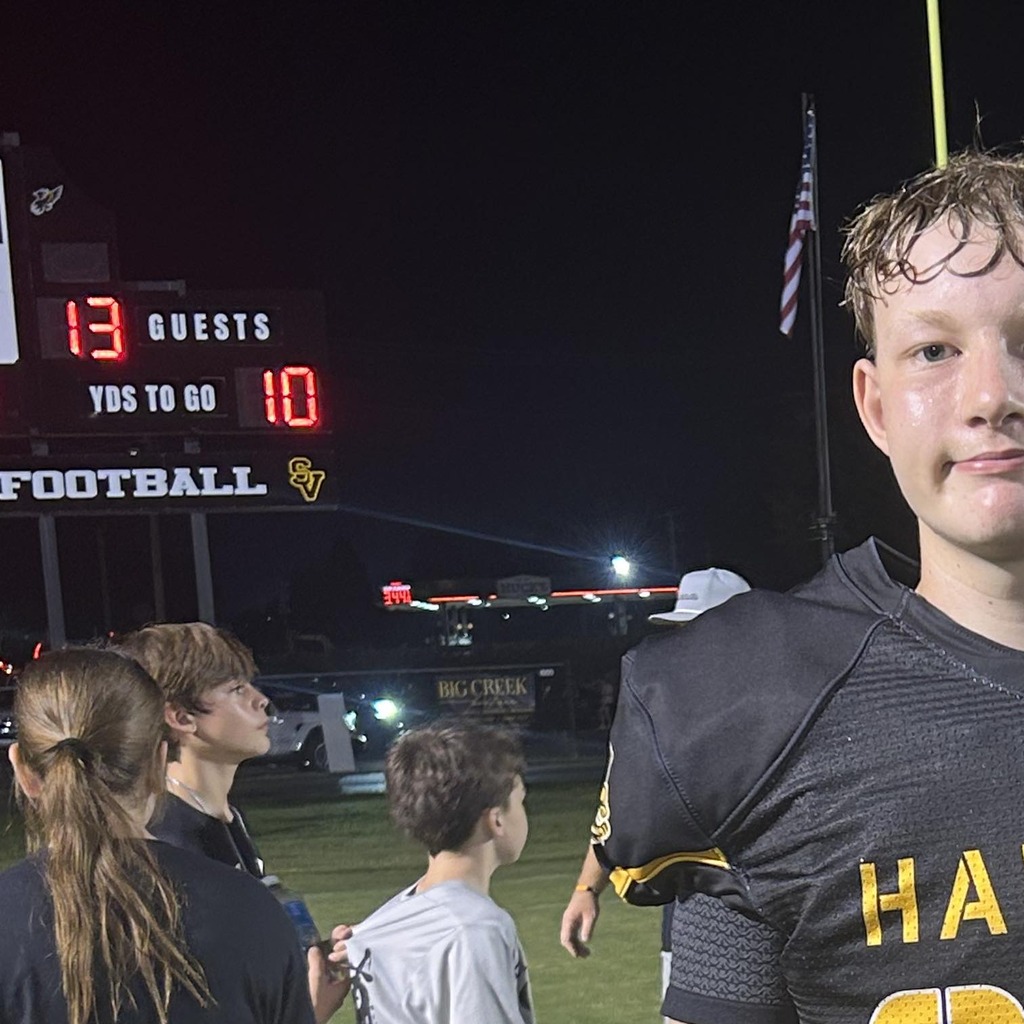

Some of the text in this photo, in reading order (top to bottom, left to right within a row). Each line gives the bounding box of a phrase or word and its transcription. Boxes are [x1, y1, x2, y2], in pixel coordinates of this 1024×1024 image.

[66, 296, 126, 360] 13
[148, 312, 271, 341] GUESTS
[89, 384, 217, 413] YDS TO GO
[263, 365, 320, 428] 10
[0, 466, 268, 500] FOOTBALL
[438, 676, 528, 698] BIG CREEK
